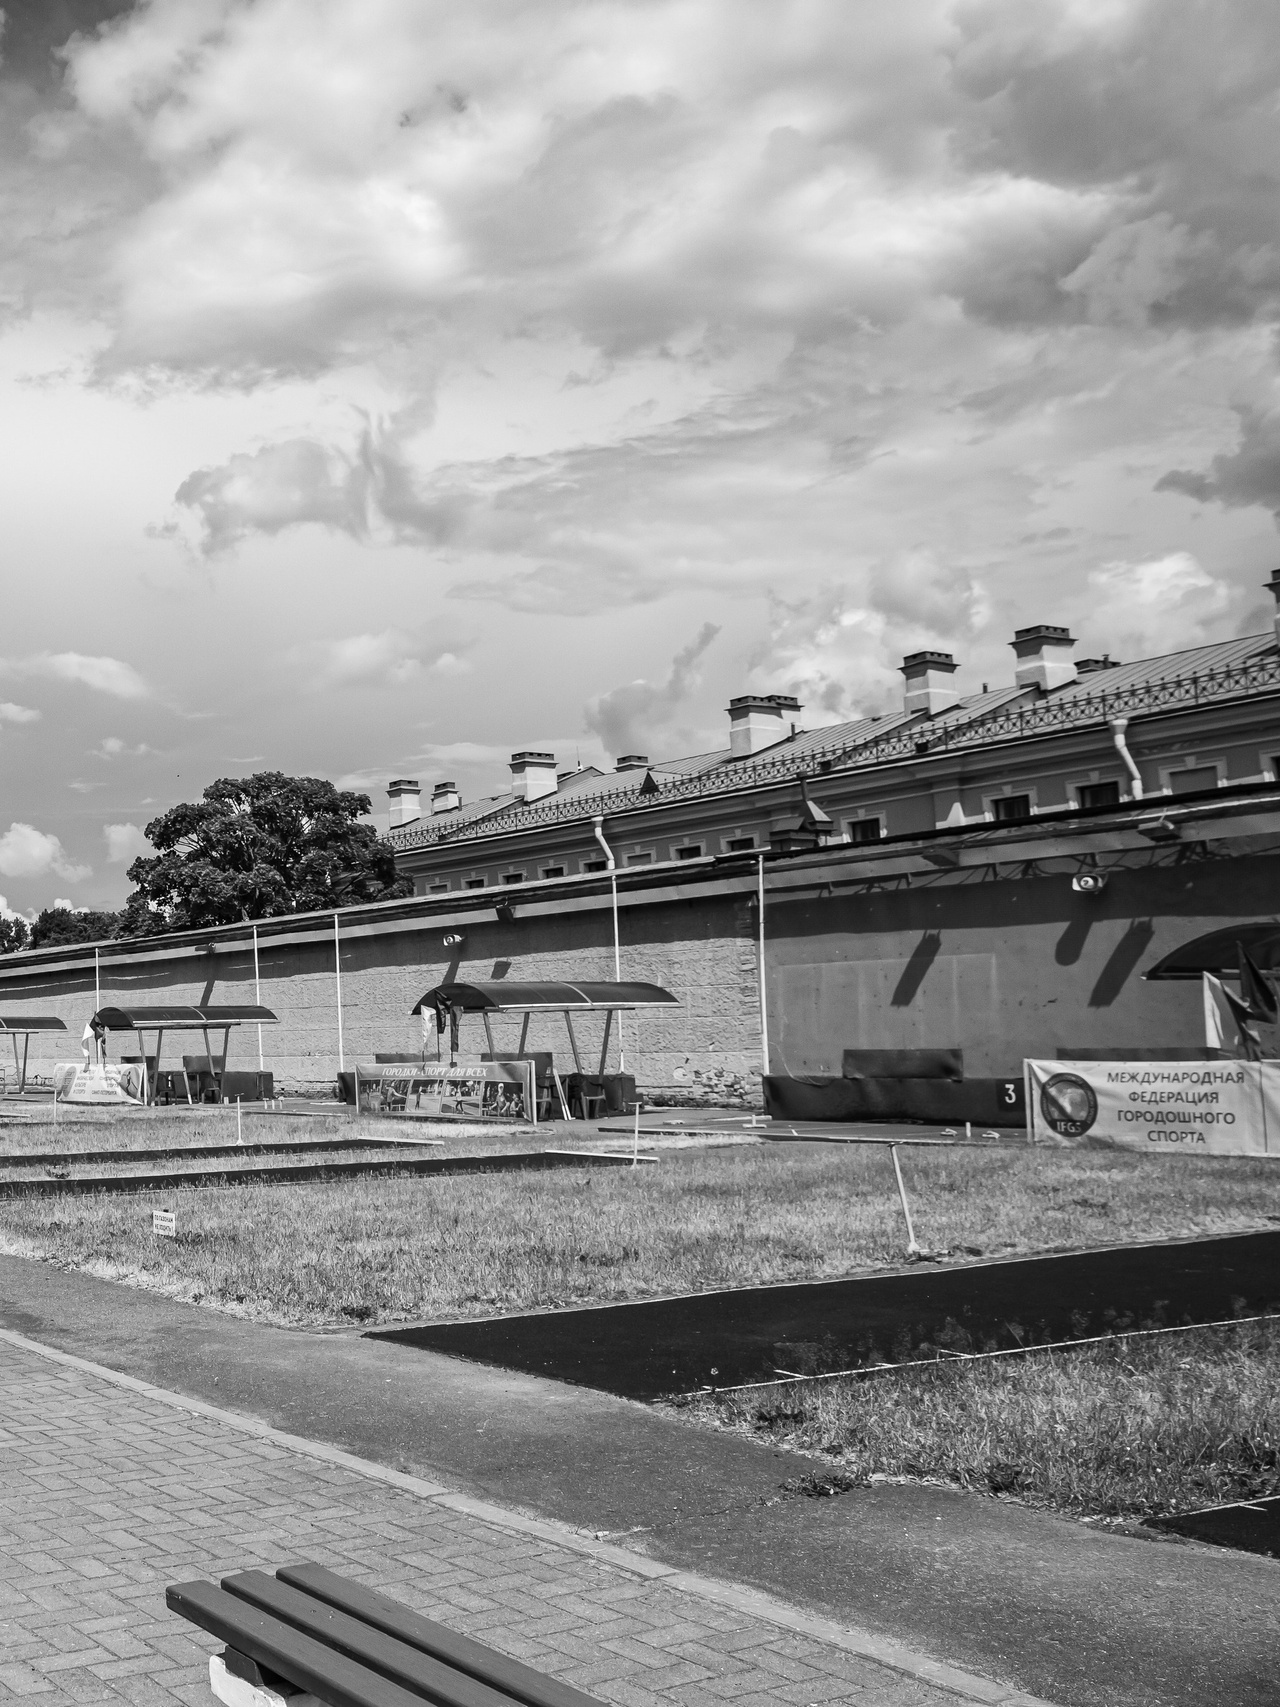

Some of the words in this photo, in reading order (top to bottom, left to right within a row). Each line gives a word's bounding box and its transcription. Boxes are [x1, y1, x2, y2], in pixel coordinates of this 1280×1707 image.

[382, 1068, 418, 1077] ГОРОДКИ
[421, 1067, 447, 1076] СПОРТ
[446, 1067, 465, 1077] ДЛЯ
[466, 1067, 488, 1077] ВСЕХ
[1107, 1071, 1245, 1085] МЕЖДУНАРОДНАЯ
[1004, 1084, 1016, 1104] 3
[1128, 1091, 1219, 1104] ФЕДЕРАЦИЯ
[1117, 1109, 1236, 1125] ГОРОДОШНОГО
[1056, 1121, 1082, 1132] IFGS
[1148, 1130, 1206, 1144] СПОРТА
